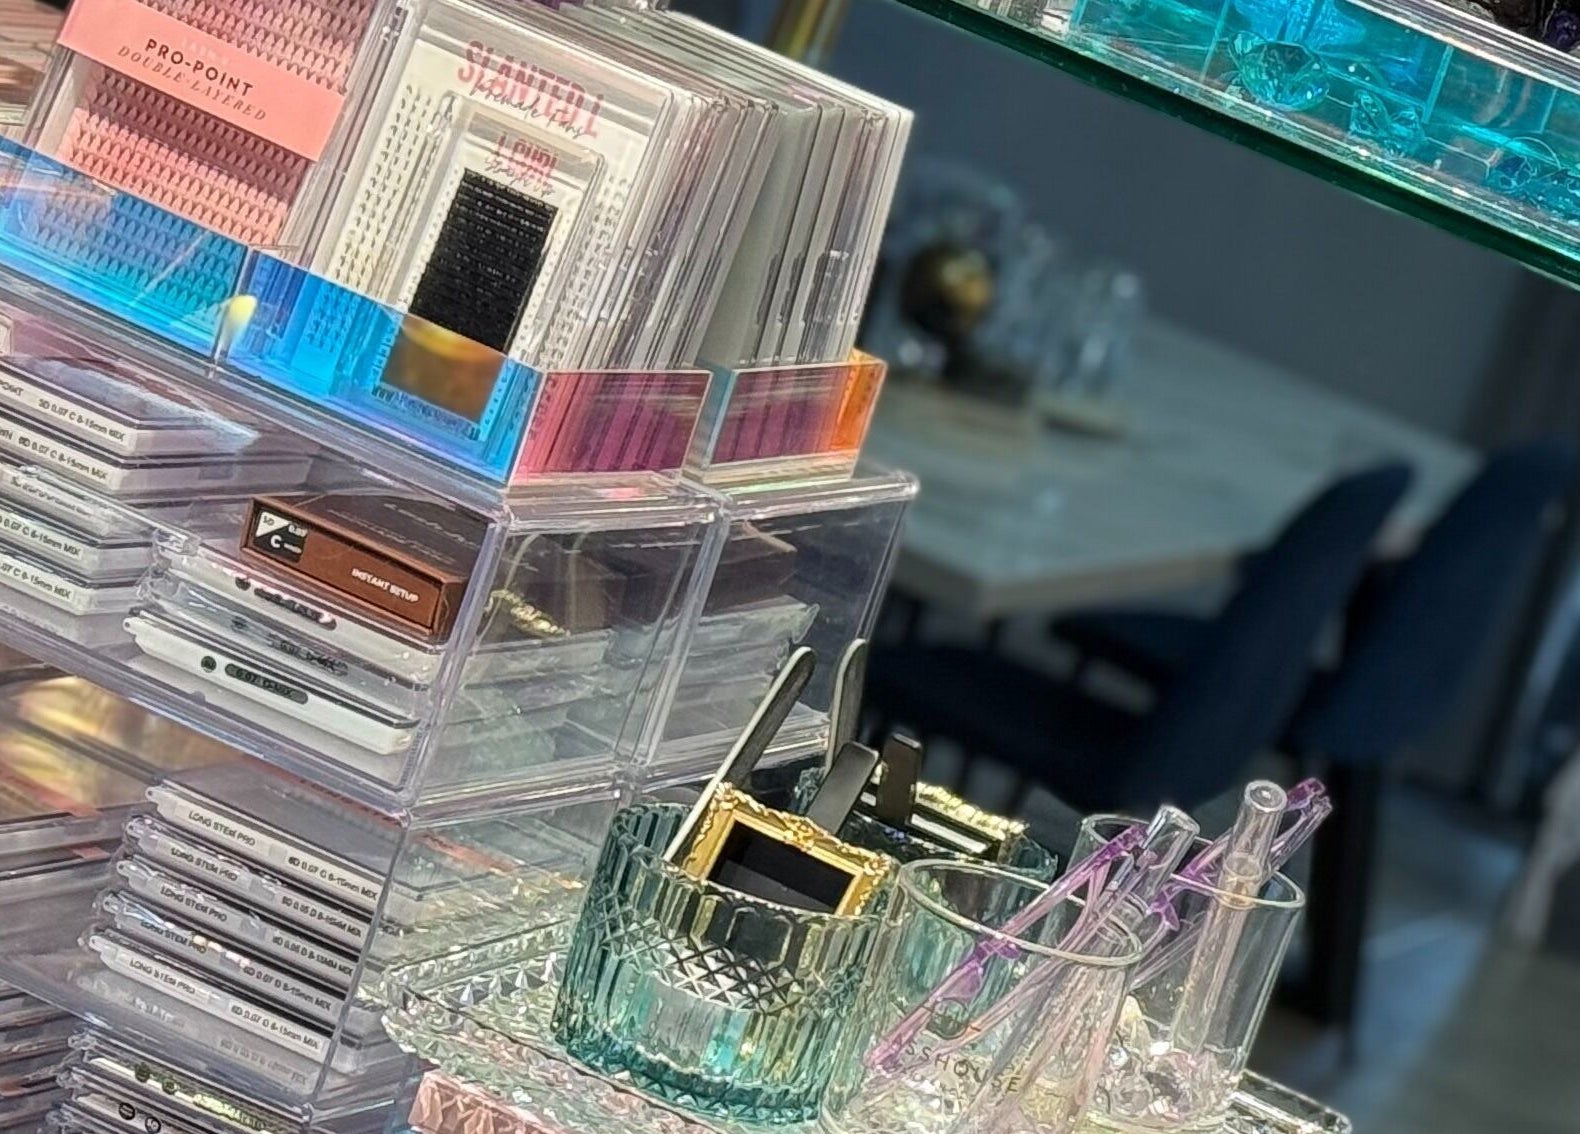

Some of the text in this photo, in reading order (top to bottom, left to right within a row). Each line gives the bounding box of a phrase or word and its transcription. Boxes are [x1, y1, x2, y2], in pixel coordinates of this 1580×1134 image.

[143, 37, 254, 99] PRO-POINT
[349, 566, 390, 591] INSTANT
[187, 810, 213, 828] LONG
[236, 831, 256, 847] PRO
[208, 907, 228, 923] PRO
[128, 958, 153, 975] LONG
[176, 979, 196, 994] PRO
